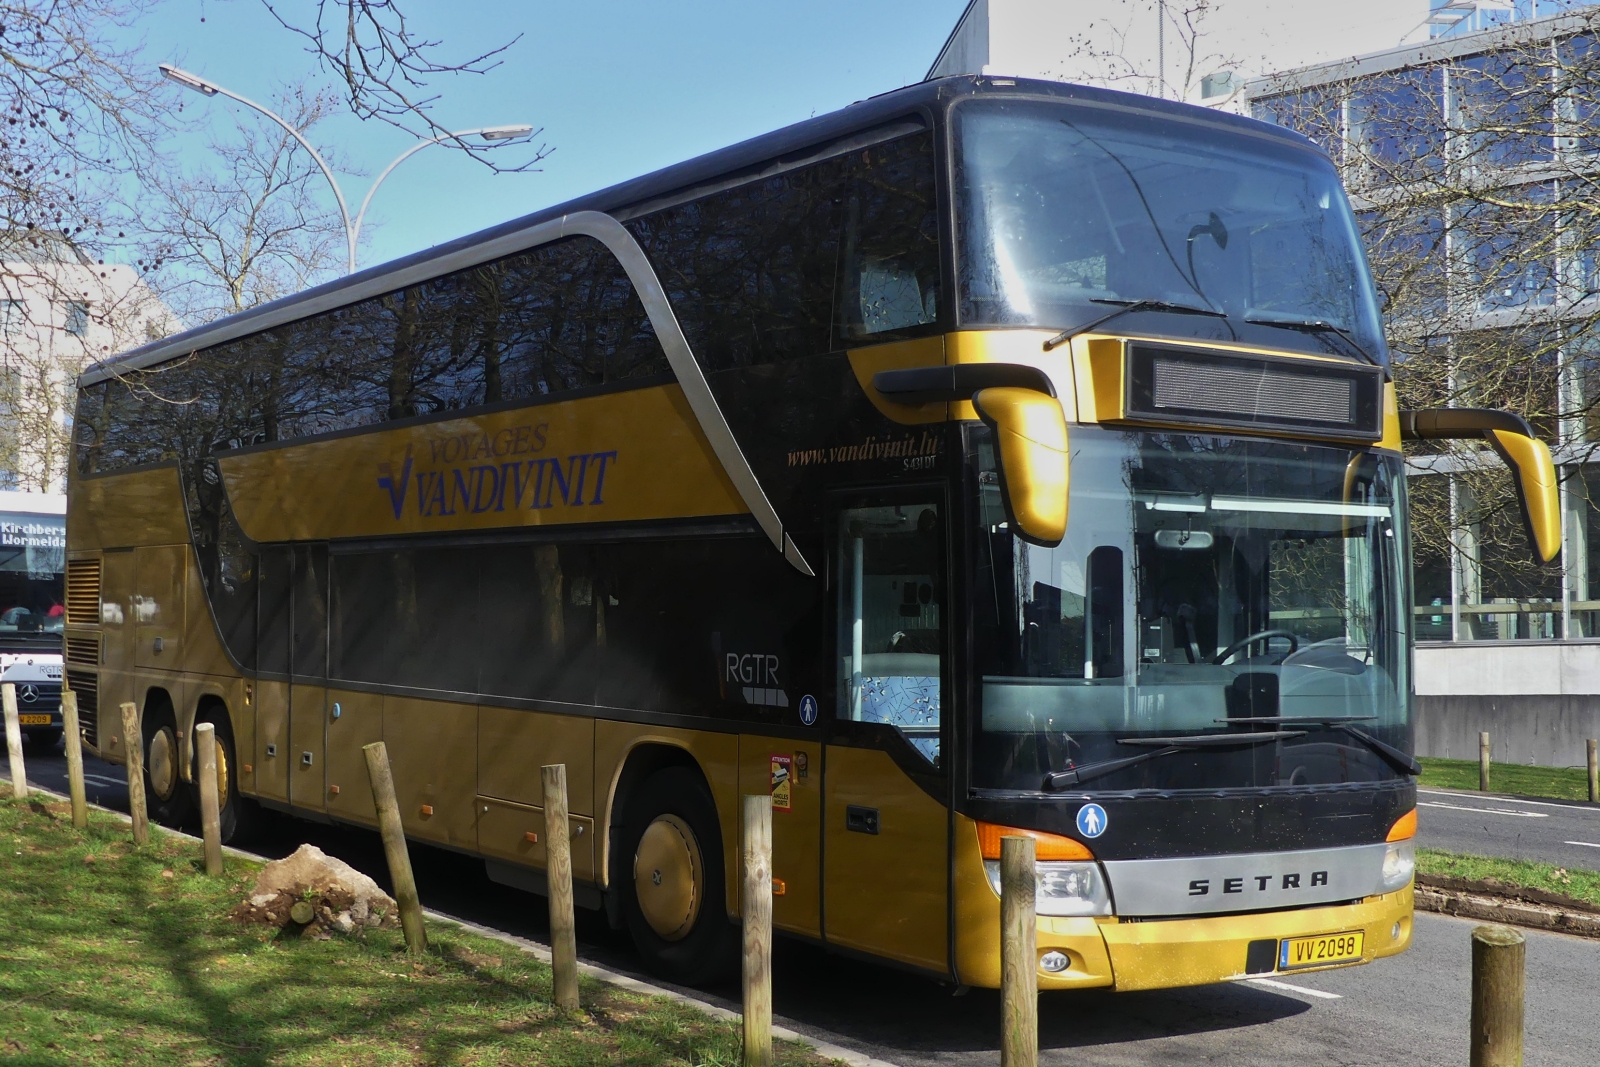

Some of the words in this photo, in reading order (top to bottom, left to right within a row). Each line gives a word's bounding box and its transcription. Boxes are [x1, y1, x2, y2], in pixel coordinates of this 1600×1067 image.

[429, 423, 549, 464] VOYAGES
[787, 431, 938, 467] www.vandivinit.lu
[903, 458, 909, 471] S
[925, 455, 936, 468] DT
[416, 451, 617, 517] VANDIVINIT
[40, 665, 63, 674] RGTR
[726, 653, 779, 685] RGTR
[27, 715, 47, 723] 2209
[1188, 870, 1328, 896] SETRA
[1296, 941, 1315, 962] VV
[1317, 937, 1355, 959] 2098
